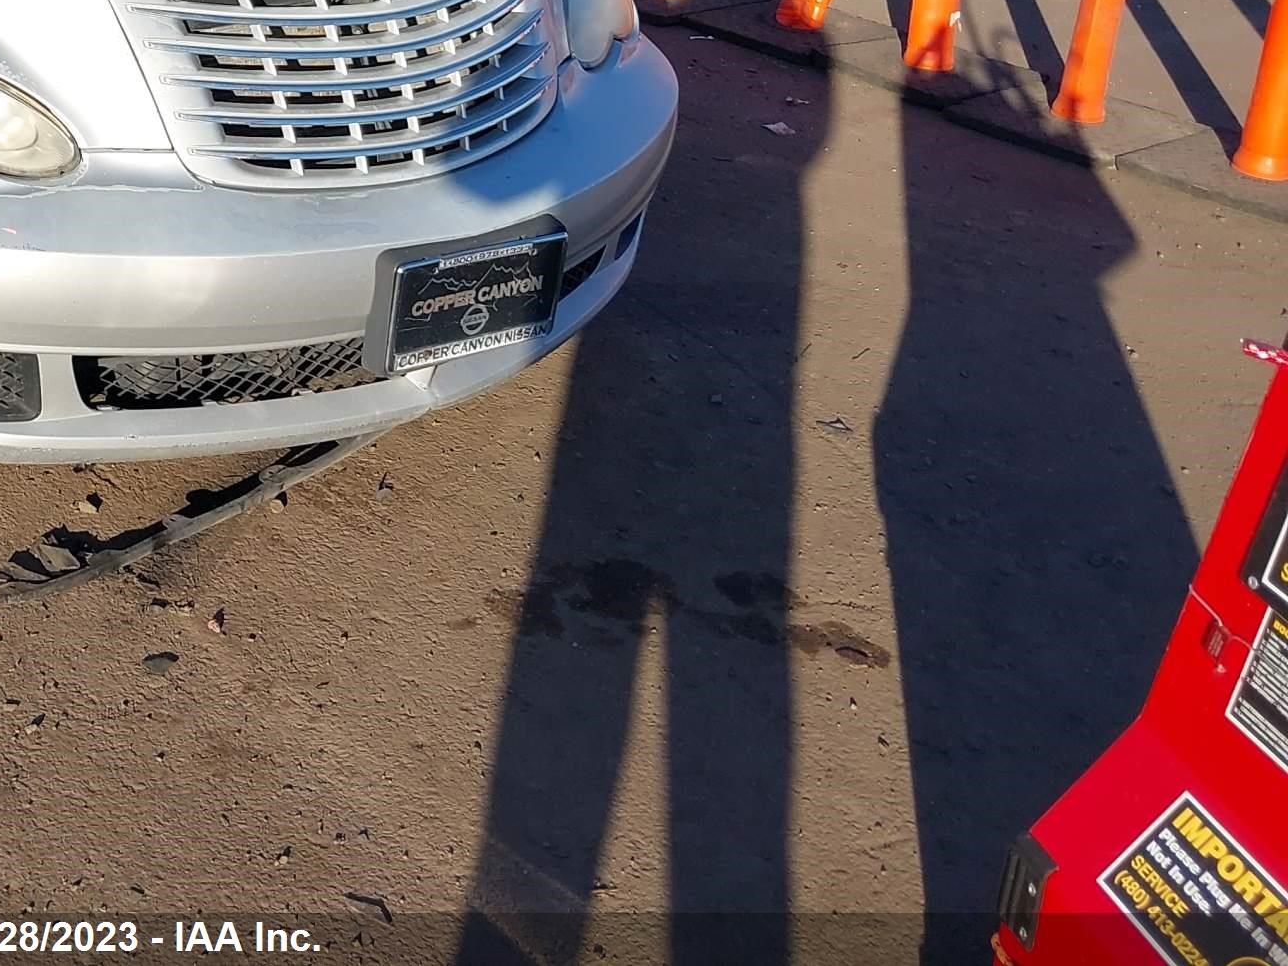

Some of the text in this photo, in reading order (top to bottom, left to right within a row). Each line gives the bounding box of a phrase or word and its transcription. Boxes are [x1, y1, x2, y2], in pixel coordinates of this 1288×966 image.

[411, 274, 544, 317] COPPER CANYON
[451, 334, 504, 356] CANYON
[504, 323, 548, 344] NISSAN
[1146, 839, 1173, 870] Not
[1158, 827, 1202, 876] Please
[1198, 870, 1233, 910] Plug
[1171, 806, 1288, 946] IMPORTA
[1114, 869, 1150, 911] (480)
[1130, 854, 1191, 921] SERVICE
